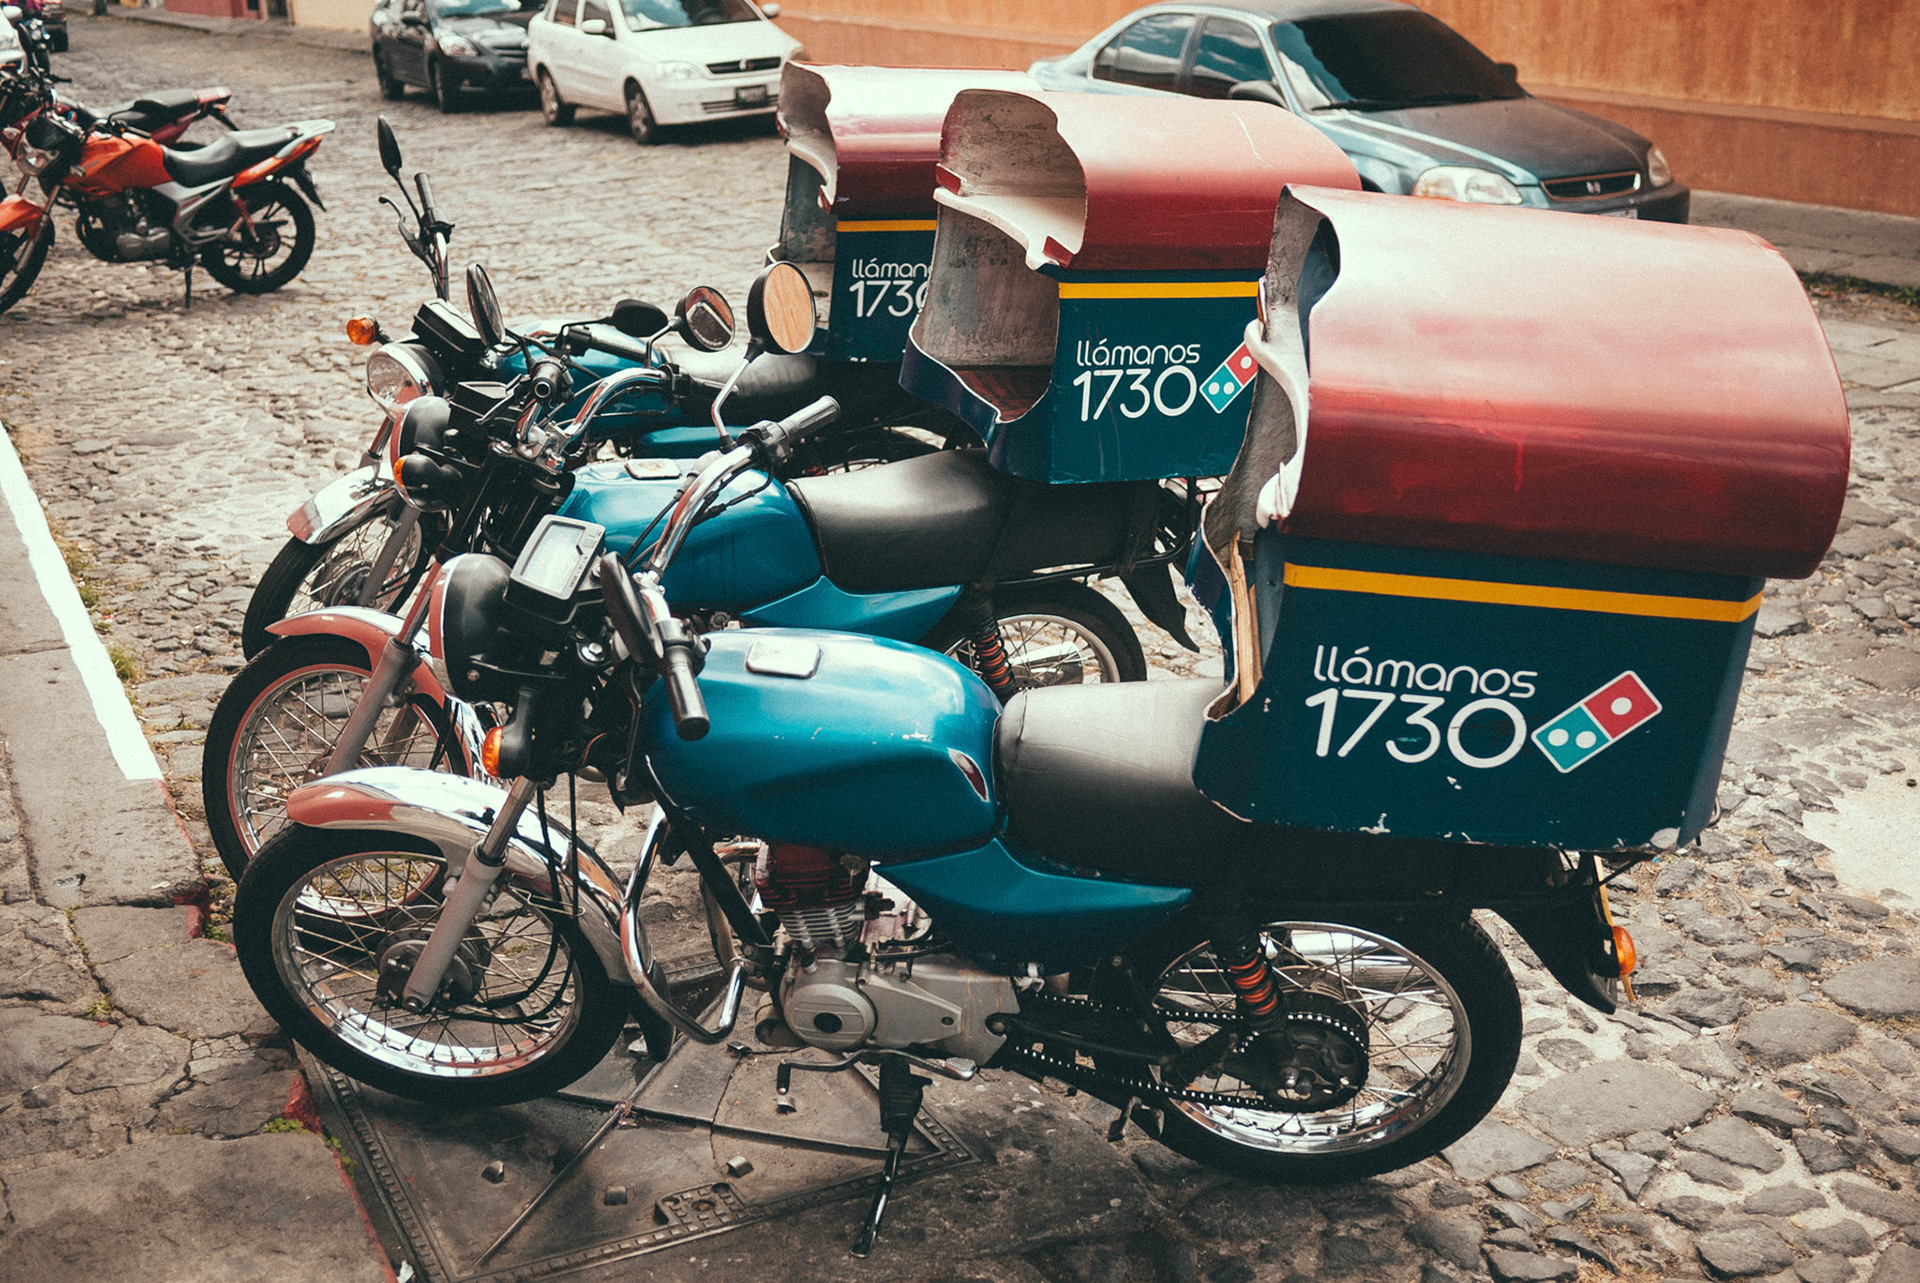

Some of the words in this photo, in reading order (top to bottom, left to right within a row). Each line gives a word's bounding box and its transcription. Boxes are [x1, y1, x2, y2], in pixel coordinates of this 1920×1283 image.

[852, 257, 932, 278] lláman
[1076, 338, 1200, 366] llámanos
[1073, 365, 1197, 422] 1730
[1314, 645, 1538, 698] llámanos
[1305, 688, 1527, 769] 1730
